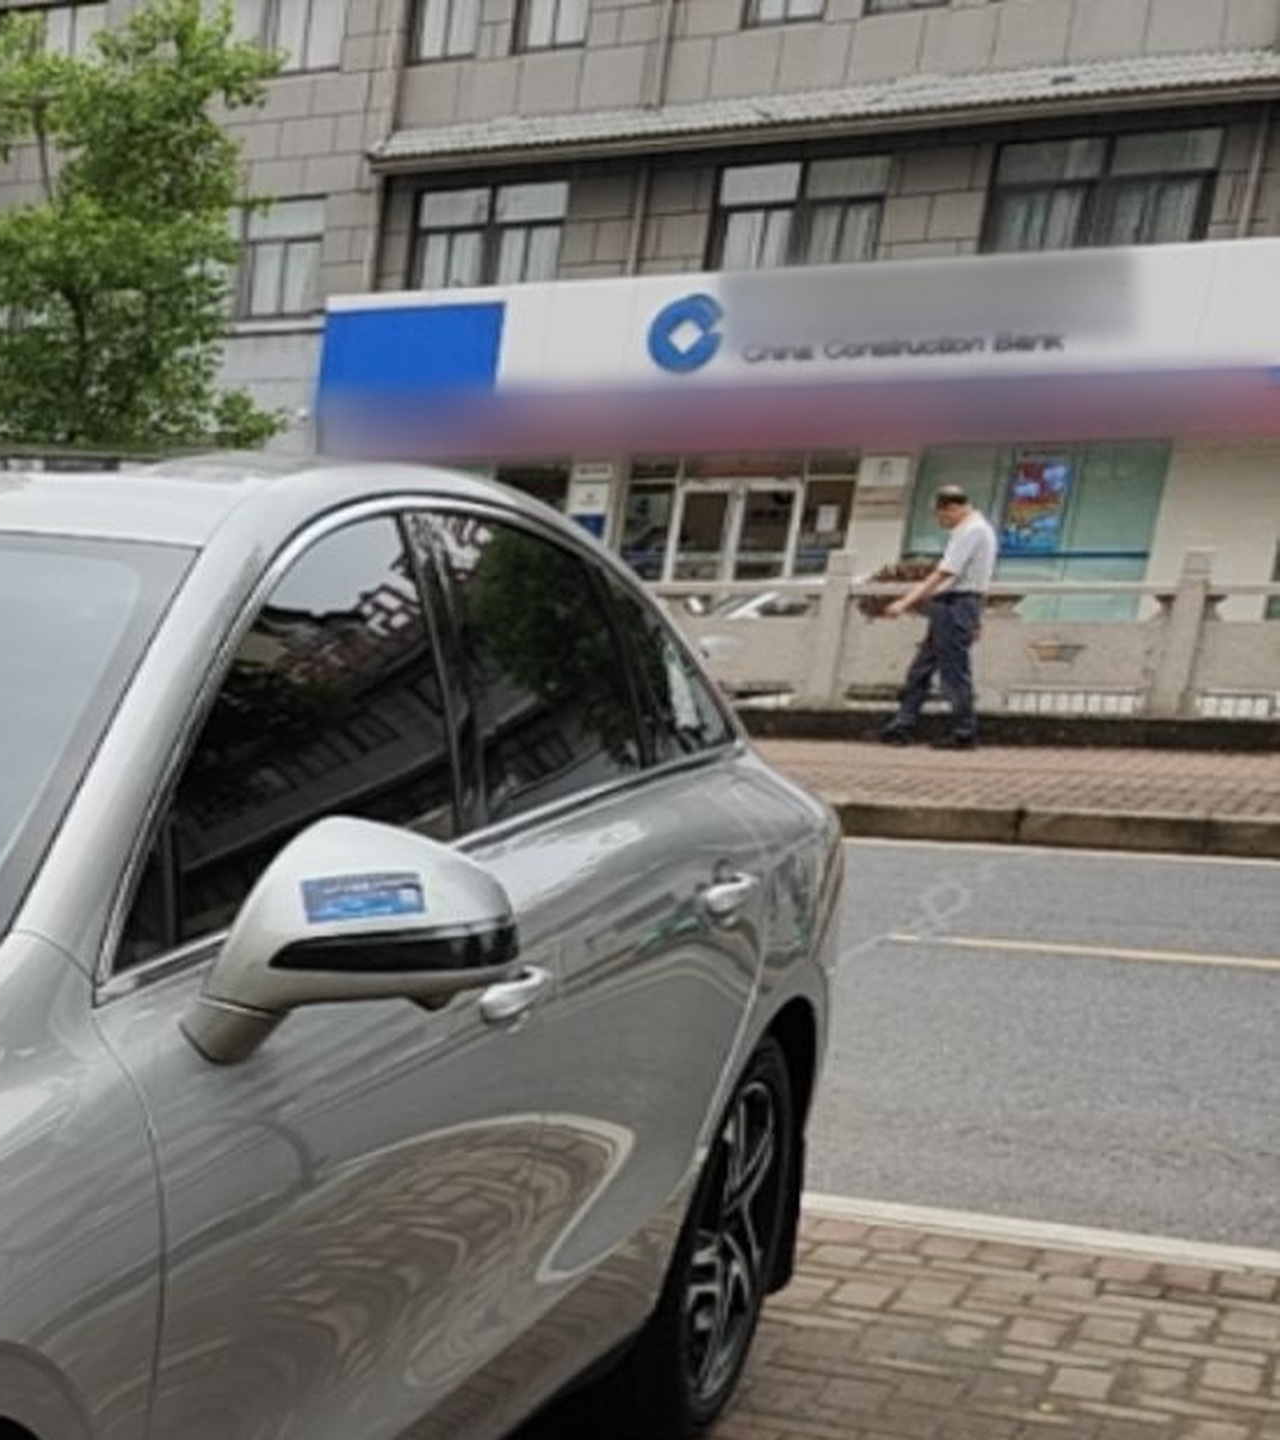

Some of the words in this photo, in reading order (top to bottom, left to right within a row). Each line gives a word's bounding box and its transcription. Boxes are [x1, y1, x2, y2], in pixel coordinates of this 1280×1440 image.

[742, 342, 814, 363] China
[824, 334, 985, 361] Construction
[991, 329, 1066, 354] Bank
